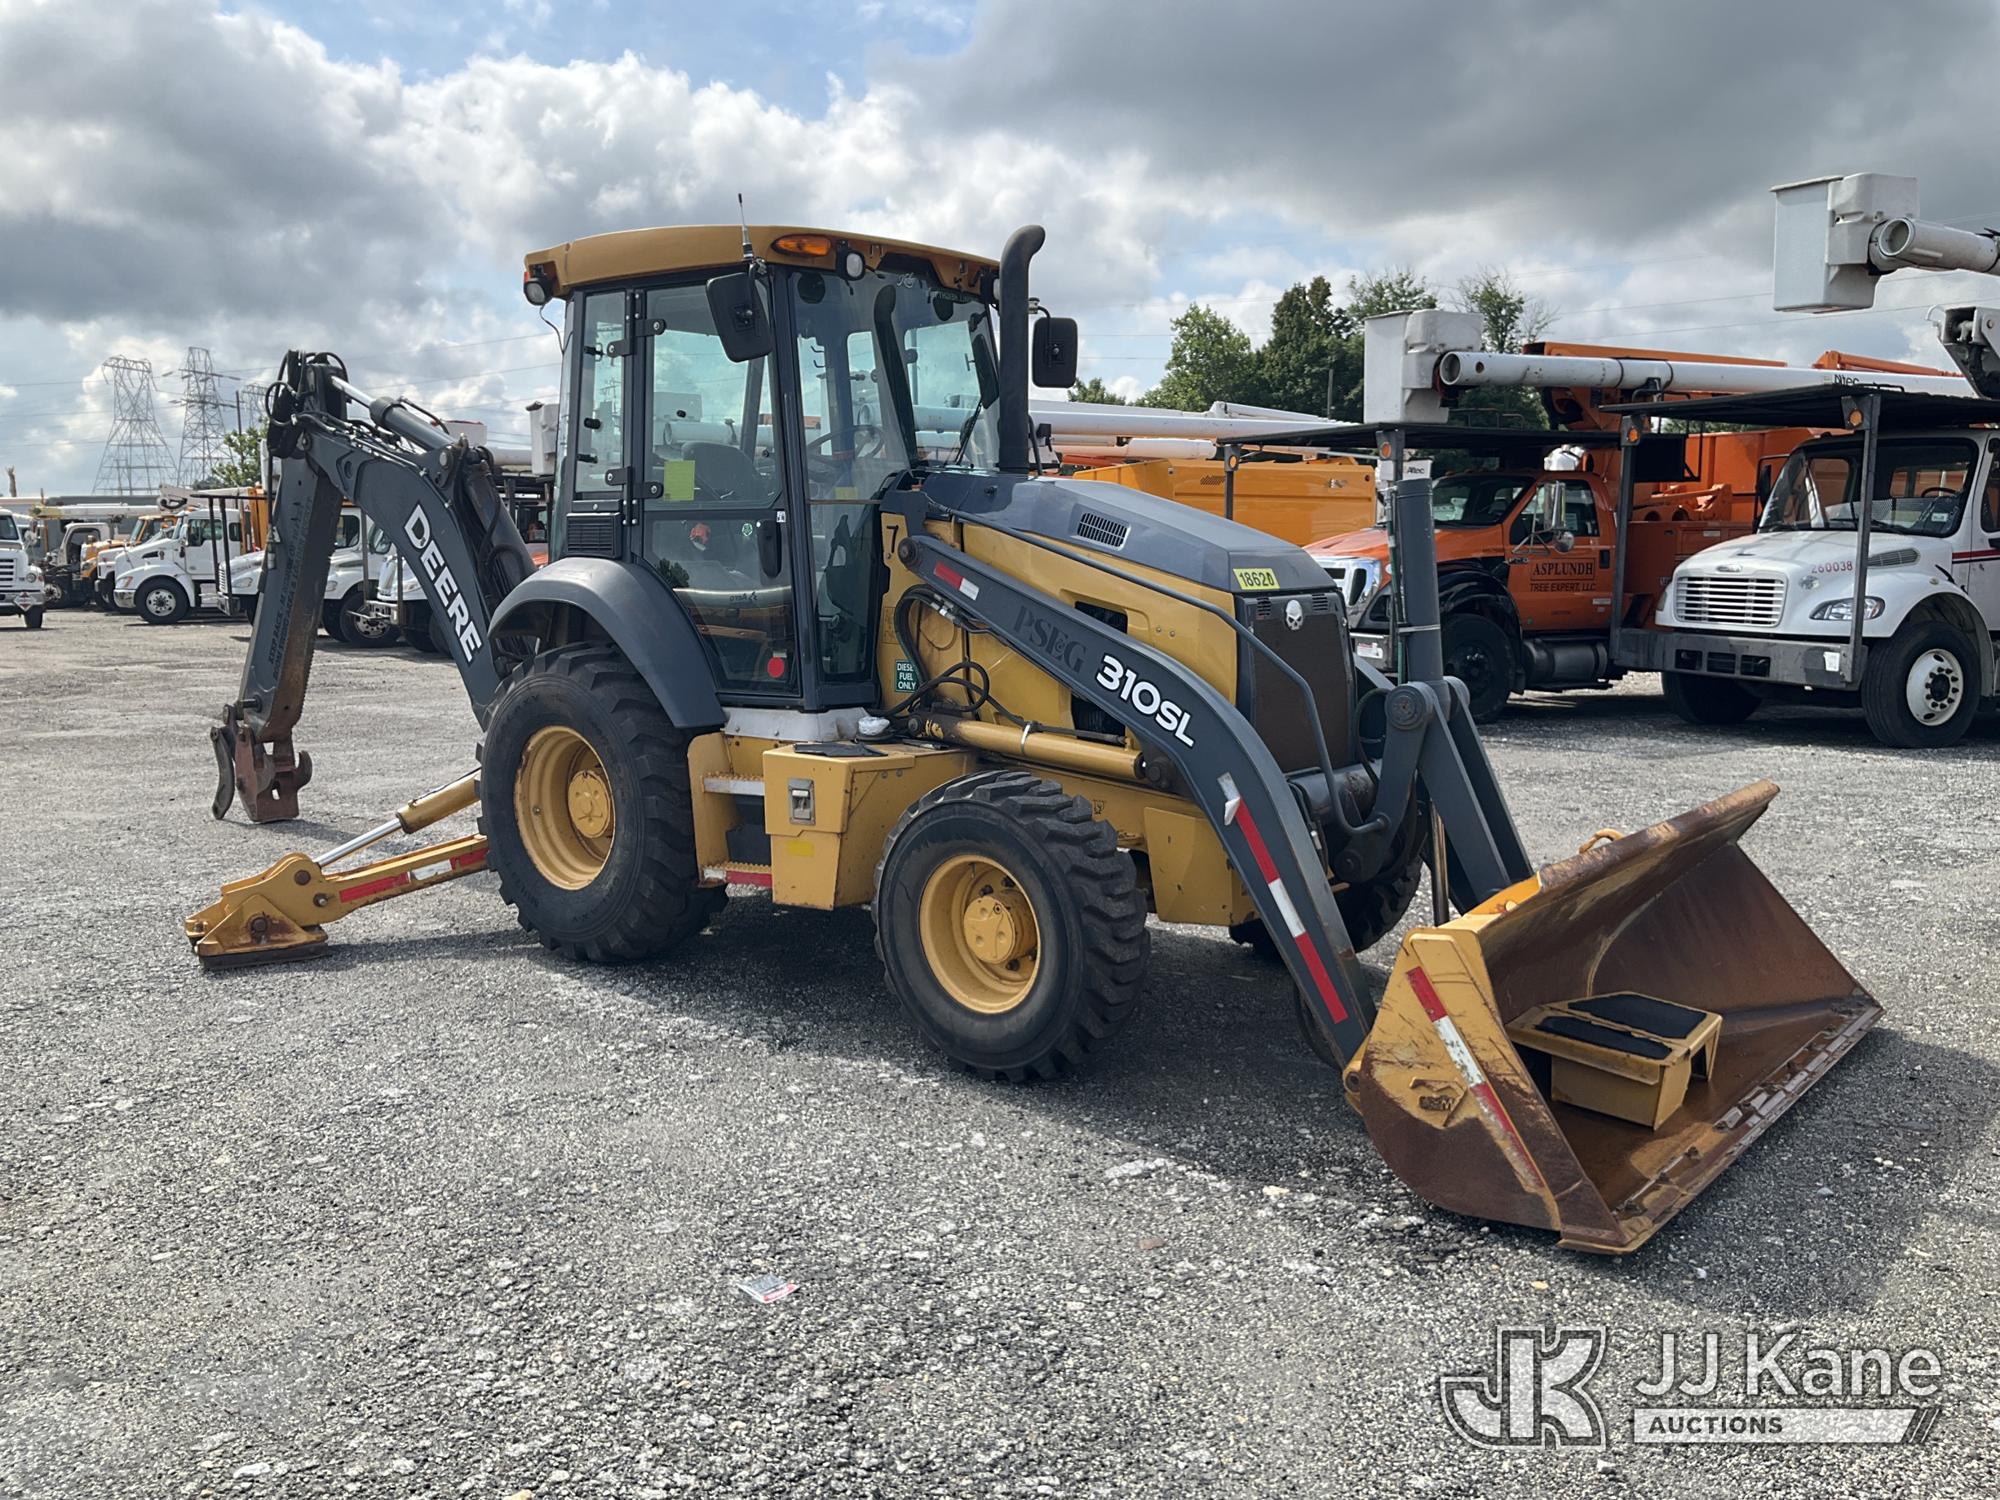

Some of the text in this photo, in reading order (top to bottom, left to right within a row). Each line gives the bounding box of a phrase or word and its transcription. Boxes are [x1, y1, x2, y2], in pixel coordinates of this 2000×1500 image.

[886, 525, 898, 553] 7
[1533, 562, 1593, 576] ASPLUNDH
[1811, 561, 1853, 574] 260038
[404, 504, 483, 663] DEERE
[1239, 572, 1275, 587] 18620
[1530, 583, 1549, 592] TREE
[1582, 582, 1596, 591] LLC
[899, 672, 913, 680] FUEL
[898, 681, 916, 690] ONLY
[1096, 655, 1194, 747] 310SL
